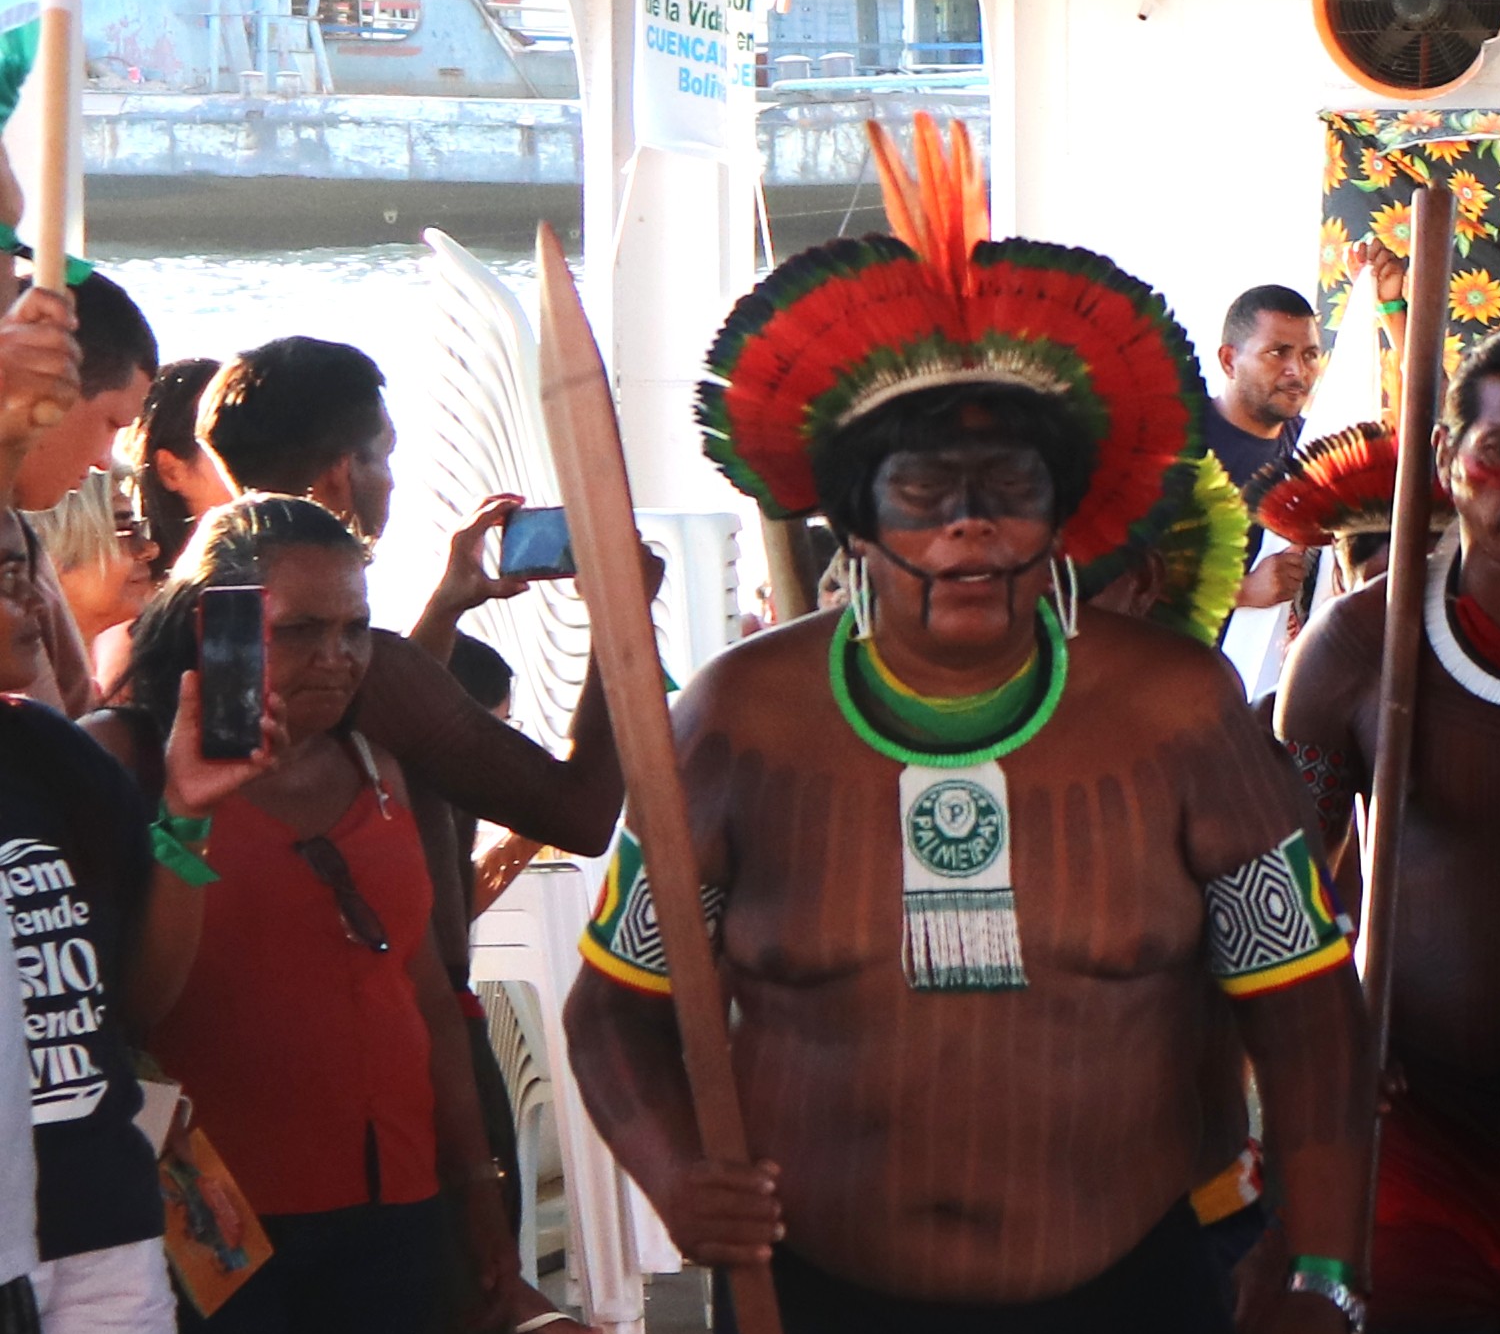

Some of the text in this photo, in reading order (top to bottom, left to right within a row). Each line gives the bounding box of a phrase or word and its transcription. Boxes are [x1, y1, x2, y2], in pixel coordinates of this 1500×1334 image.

[646, 24, 718, 65] CUENCA
[951, 804, 963, 822] P
[912, 815, 998, 868] PALMEIRAS
[30, 1043, 103, 1089] VID
